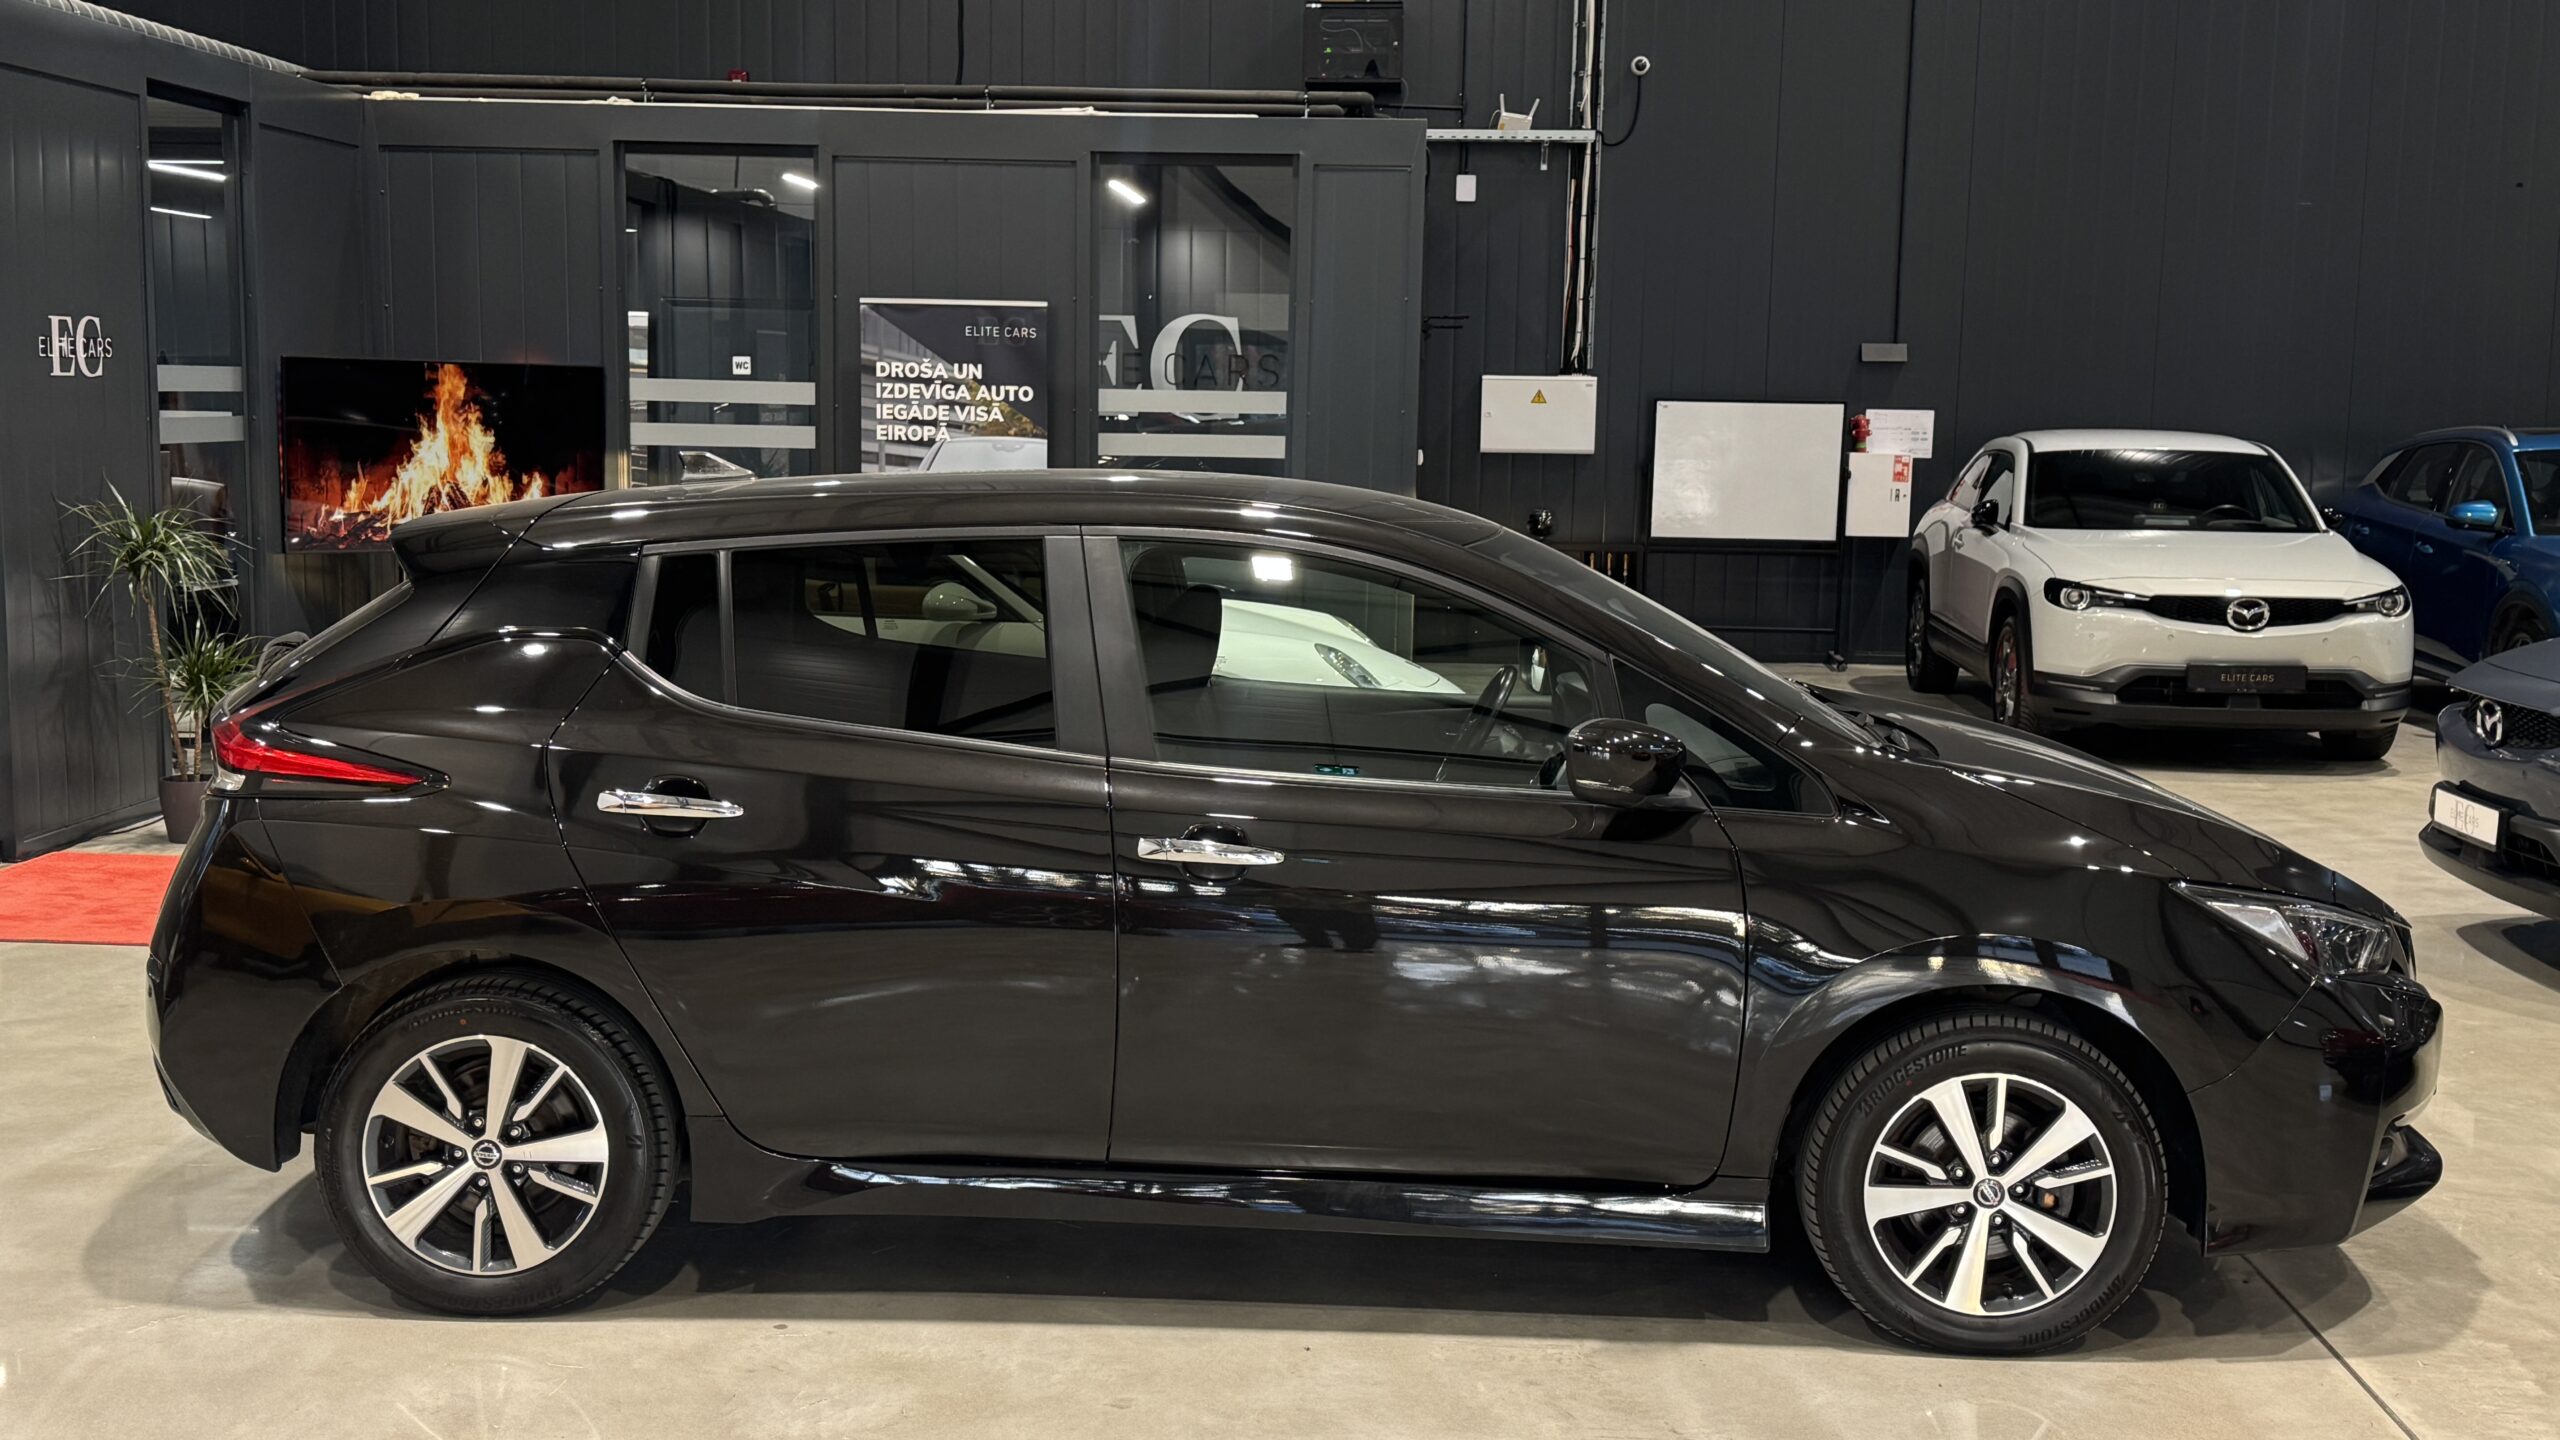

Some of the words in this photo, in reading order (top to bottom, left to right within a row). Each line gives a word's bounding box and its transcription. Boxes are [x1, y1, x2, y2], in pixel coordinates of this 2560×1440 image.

[965, 325, 1000, 338] ELITE
[1004, 326, 1037, 339] CARS
[38, 336, 76, 358] ELTE
[81, 337, 113, 358] CARS
[48, 315, 103, 377] EC
[735, 361, 749, 370] WC
[875, 358, 948, 379] DROŠA
[953, 363, 983, 380] UN
[875, 380, 971, 400] IZDEVĪGA
[975, 385, 1035, 402] AUTO
[875, 401, 950, 421] IEGĀDE
[954, 403, 1004, 422] VISĀ
[875, 423, 951, 442] EIROPĀ
[2220, 673, 2247, 682] ELITE
[2249, 674, 2275, 683] CARS
[1858, 1044, 1968, 1118] BRIDGESTONE
[2016, 1274, 2126, 1347] BRIDGESTONE
